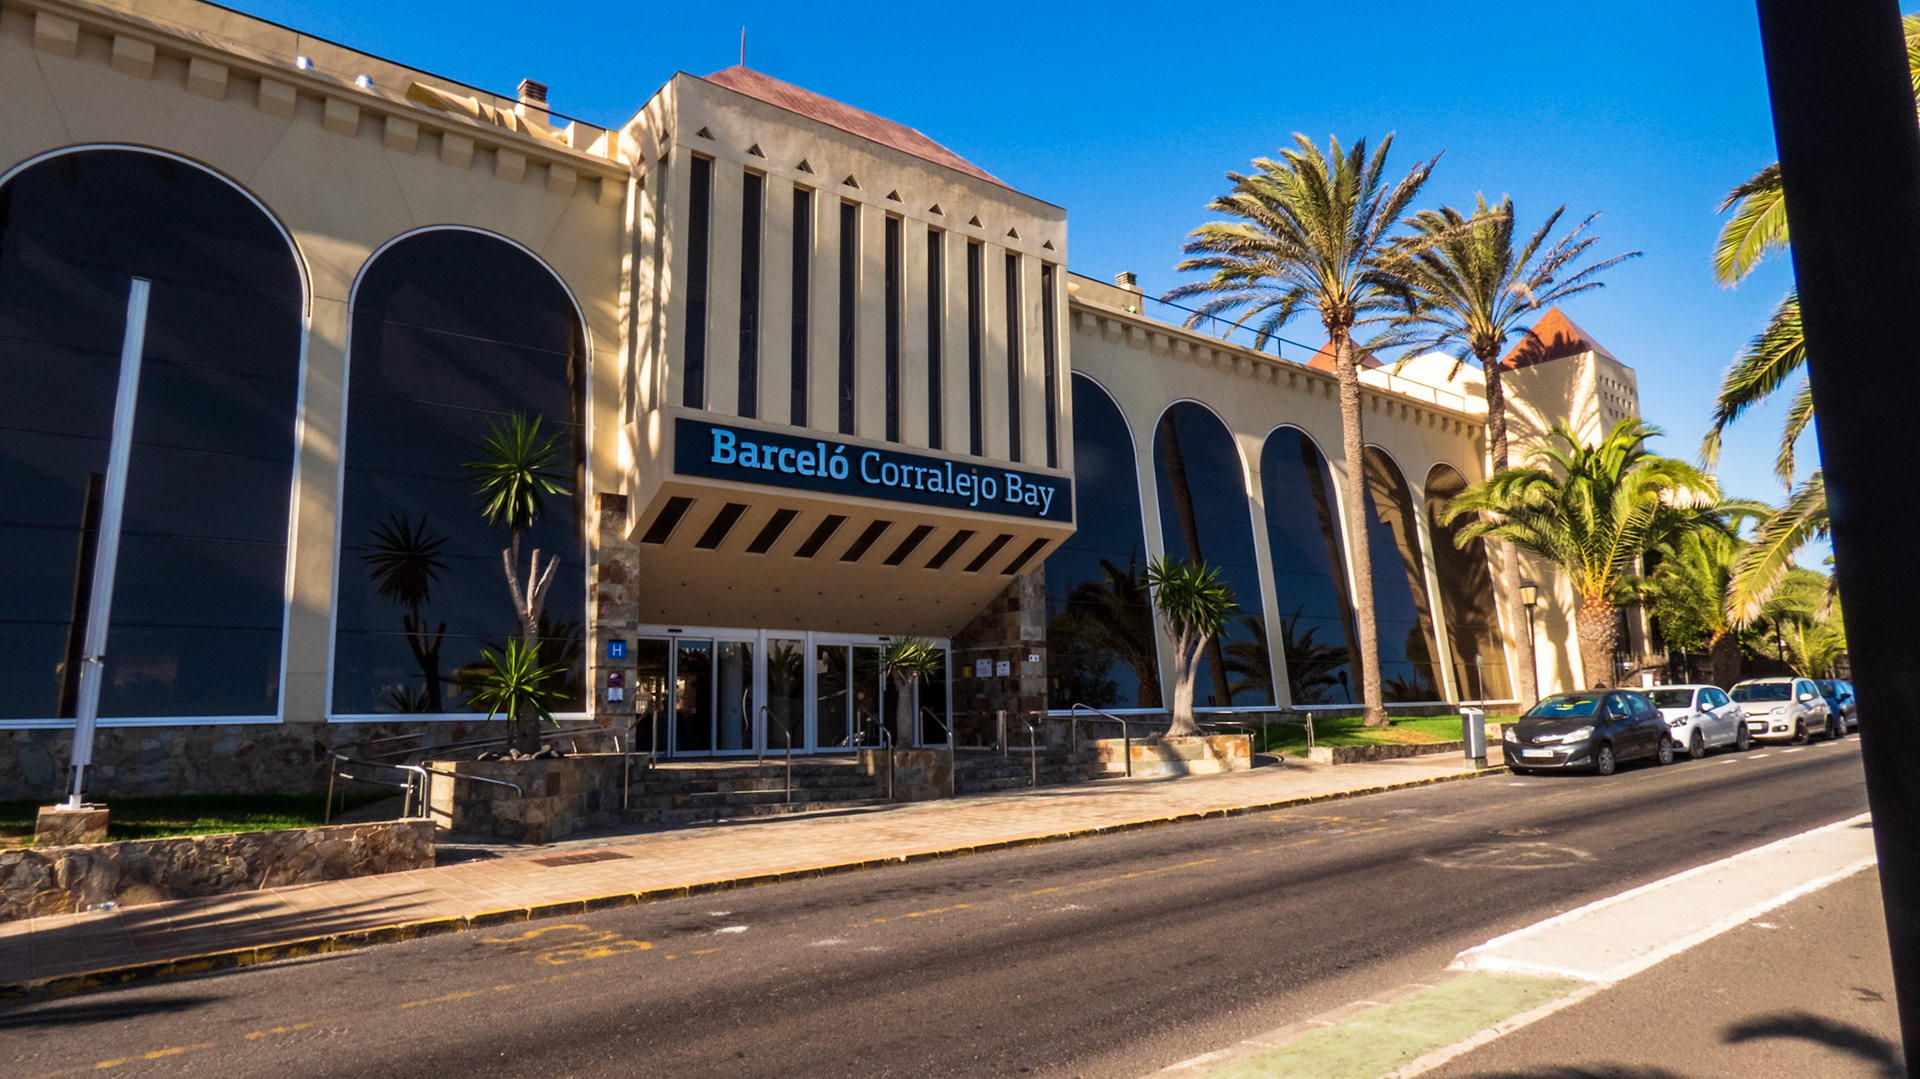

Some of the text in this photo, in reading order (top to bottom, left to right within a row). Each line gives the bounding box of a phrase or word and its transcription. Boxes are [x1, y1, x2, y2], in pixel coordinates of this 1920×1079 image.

[710, 428, 1055, 516] Barceló Corralejo Bay
[612, 644, 622, 657] H
